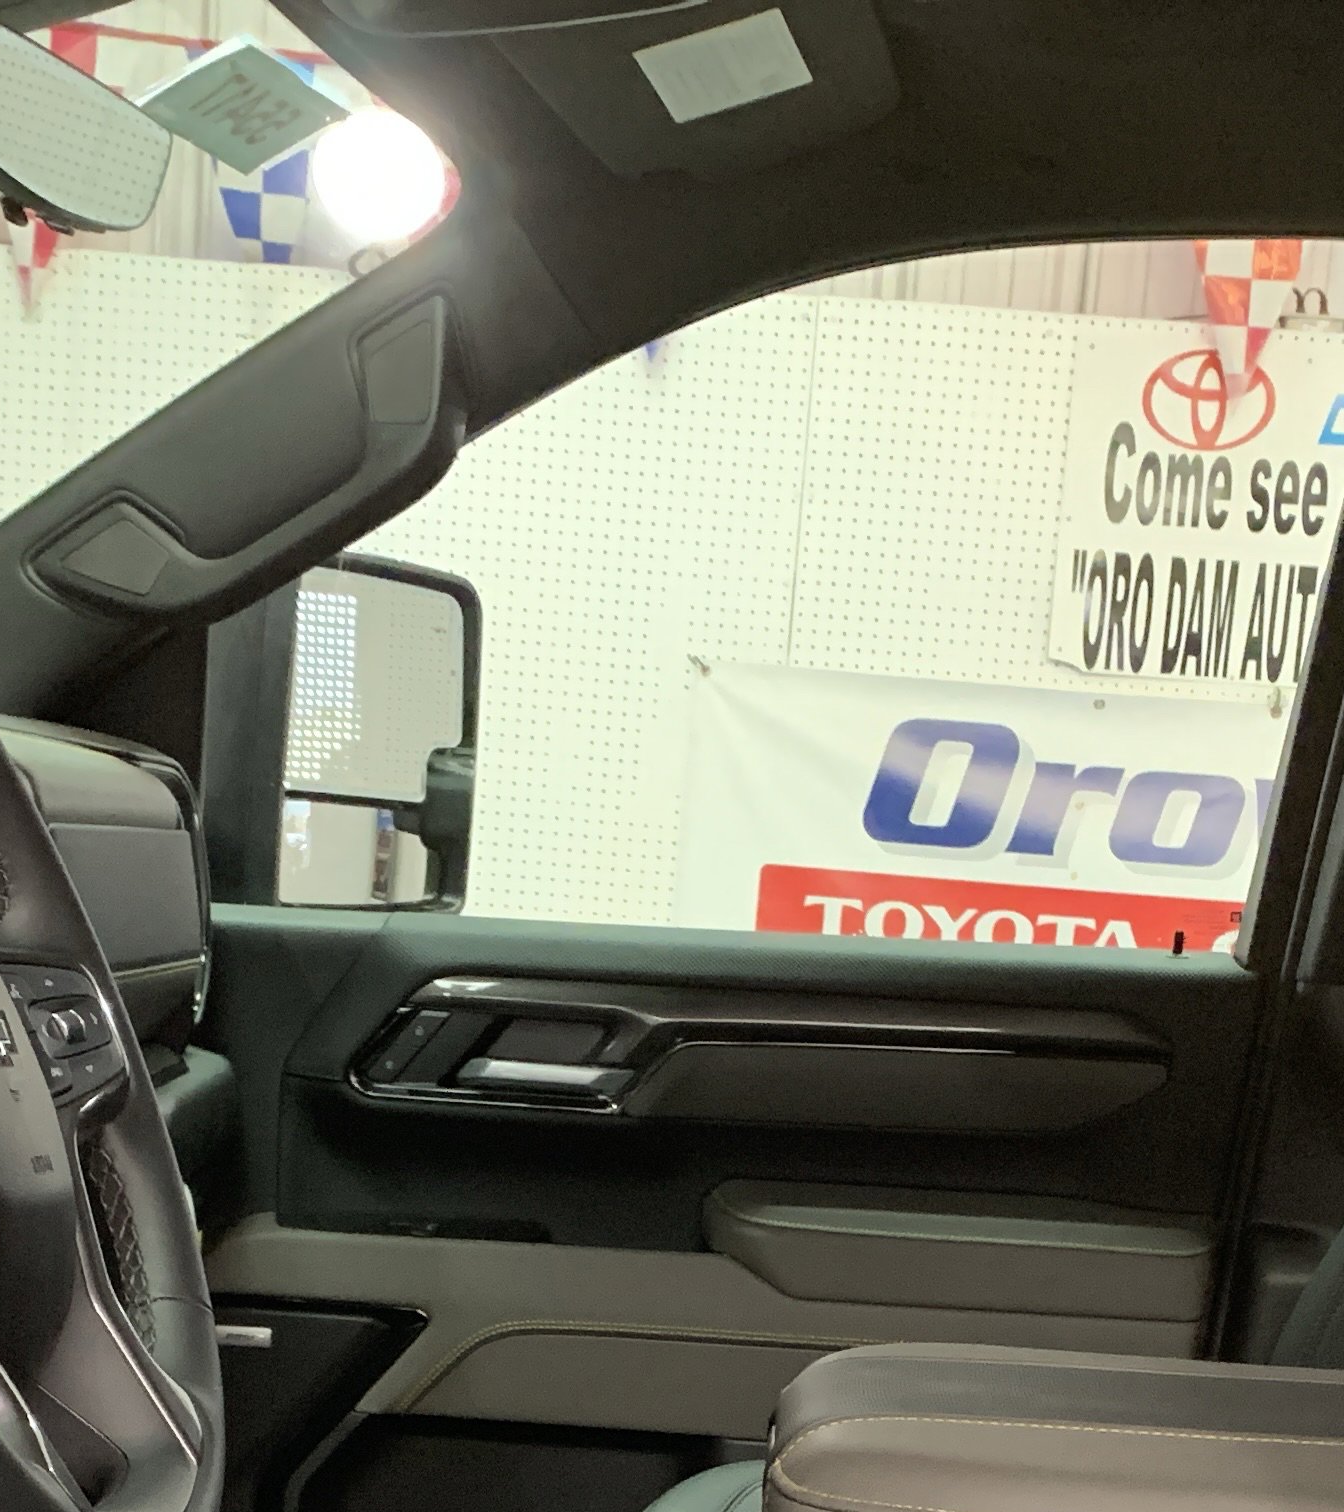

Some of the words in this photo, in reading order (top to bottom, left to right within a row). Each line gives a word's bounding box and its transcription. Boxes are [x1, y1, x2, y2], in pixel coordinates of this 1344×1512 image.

[1103, 422, 1233, 530] Come
[1246, 459, 1328, 536] see
[1071, 549, 1155, 672] "ORO
[1160, 556, 1240, 678] DAM
[862, 718, 1273, 867] Oro
